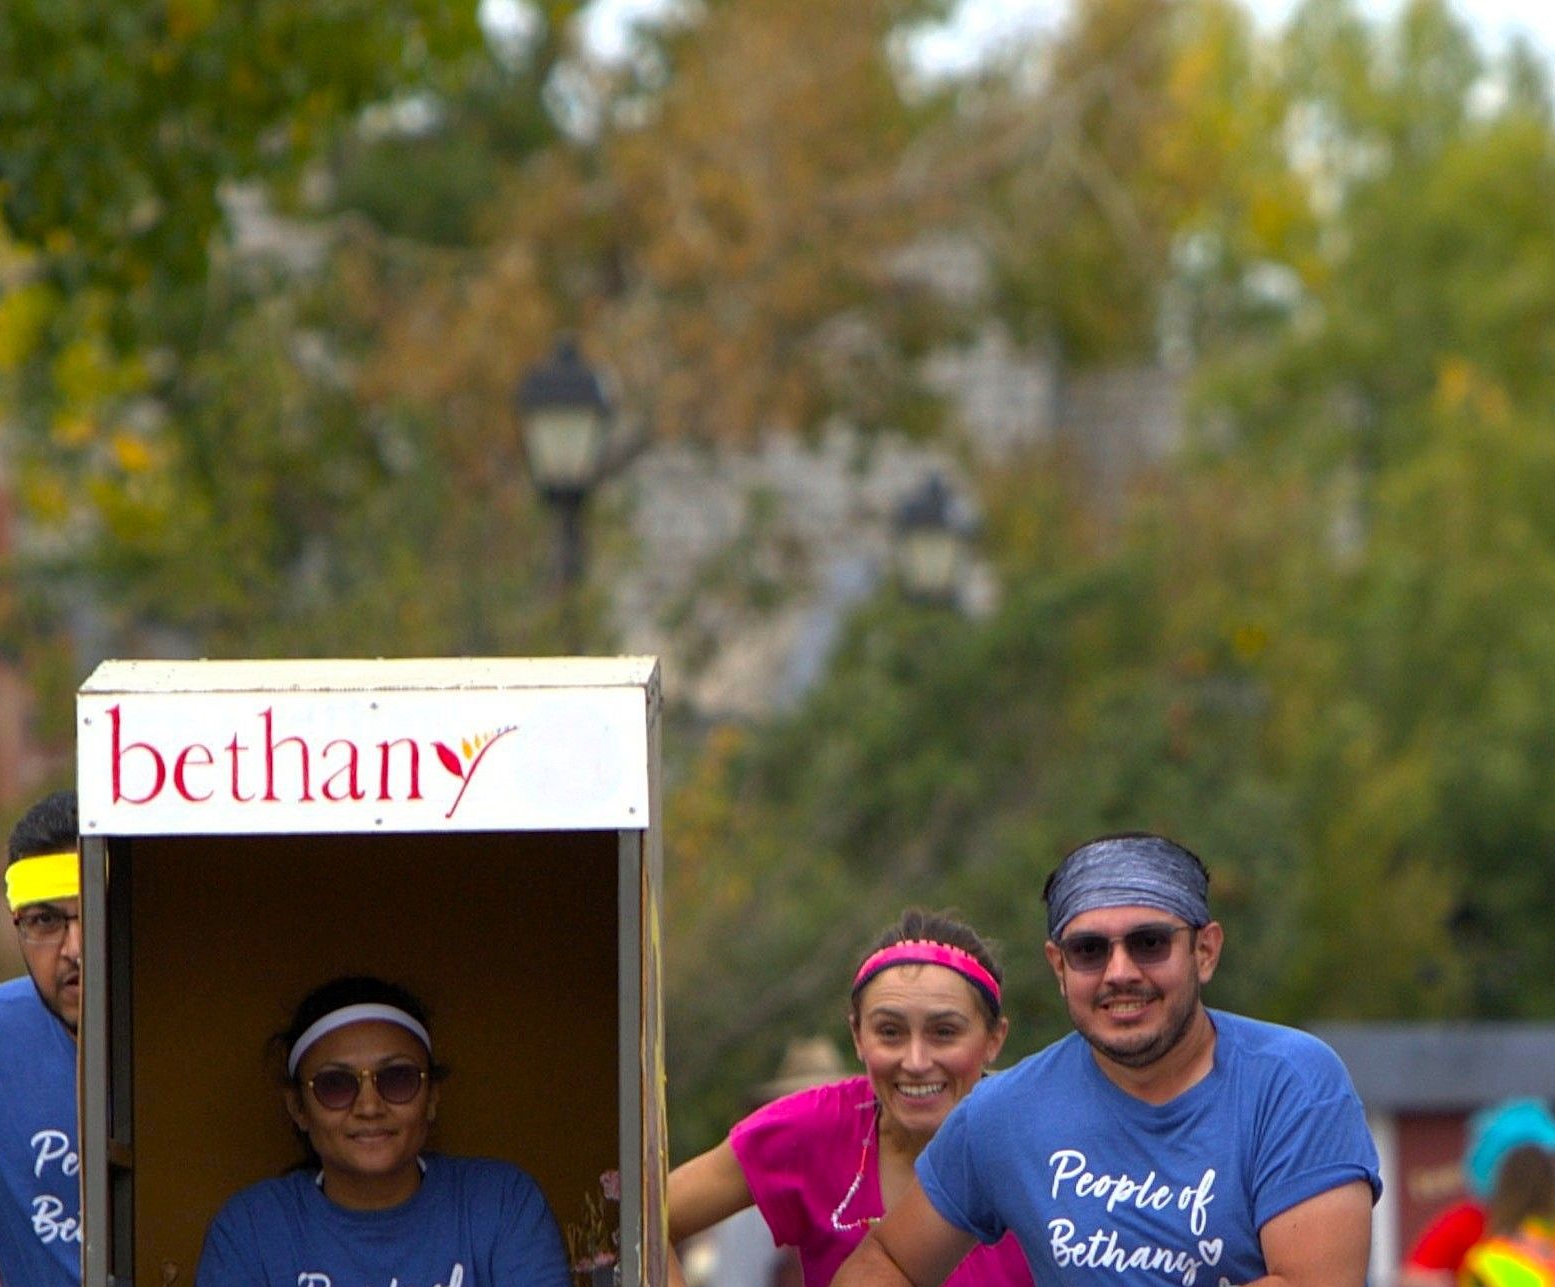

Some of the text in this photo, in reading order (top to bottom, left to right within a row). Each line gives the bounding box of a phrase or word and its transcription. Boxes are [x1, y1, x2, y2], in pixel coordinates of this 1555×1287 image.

[104, 703, 518, 819] bethany
[1049, 1150, 1215, 1236] People of
[1048, 1218, 1202, 1287] Bethany
